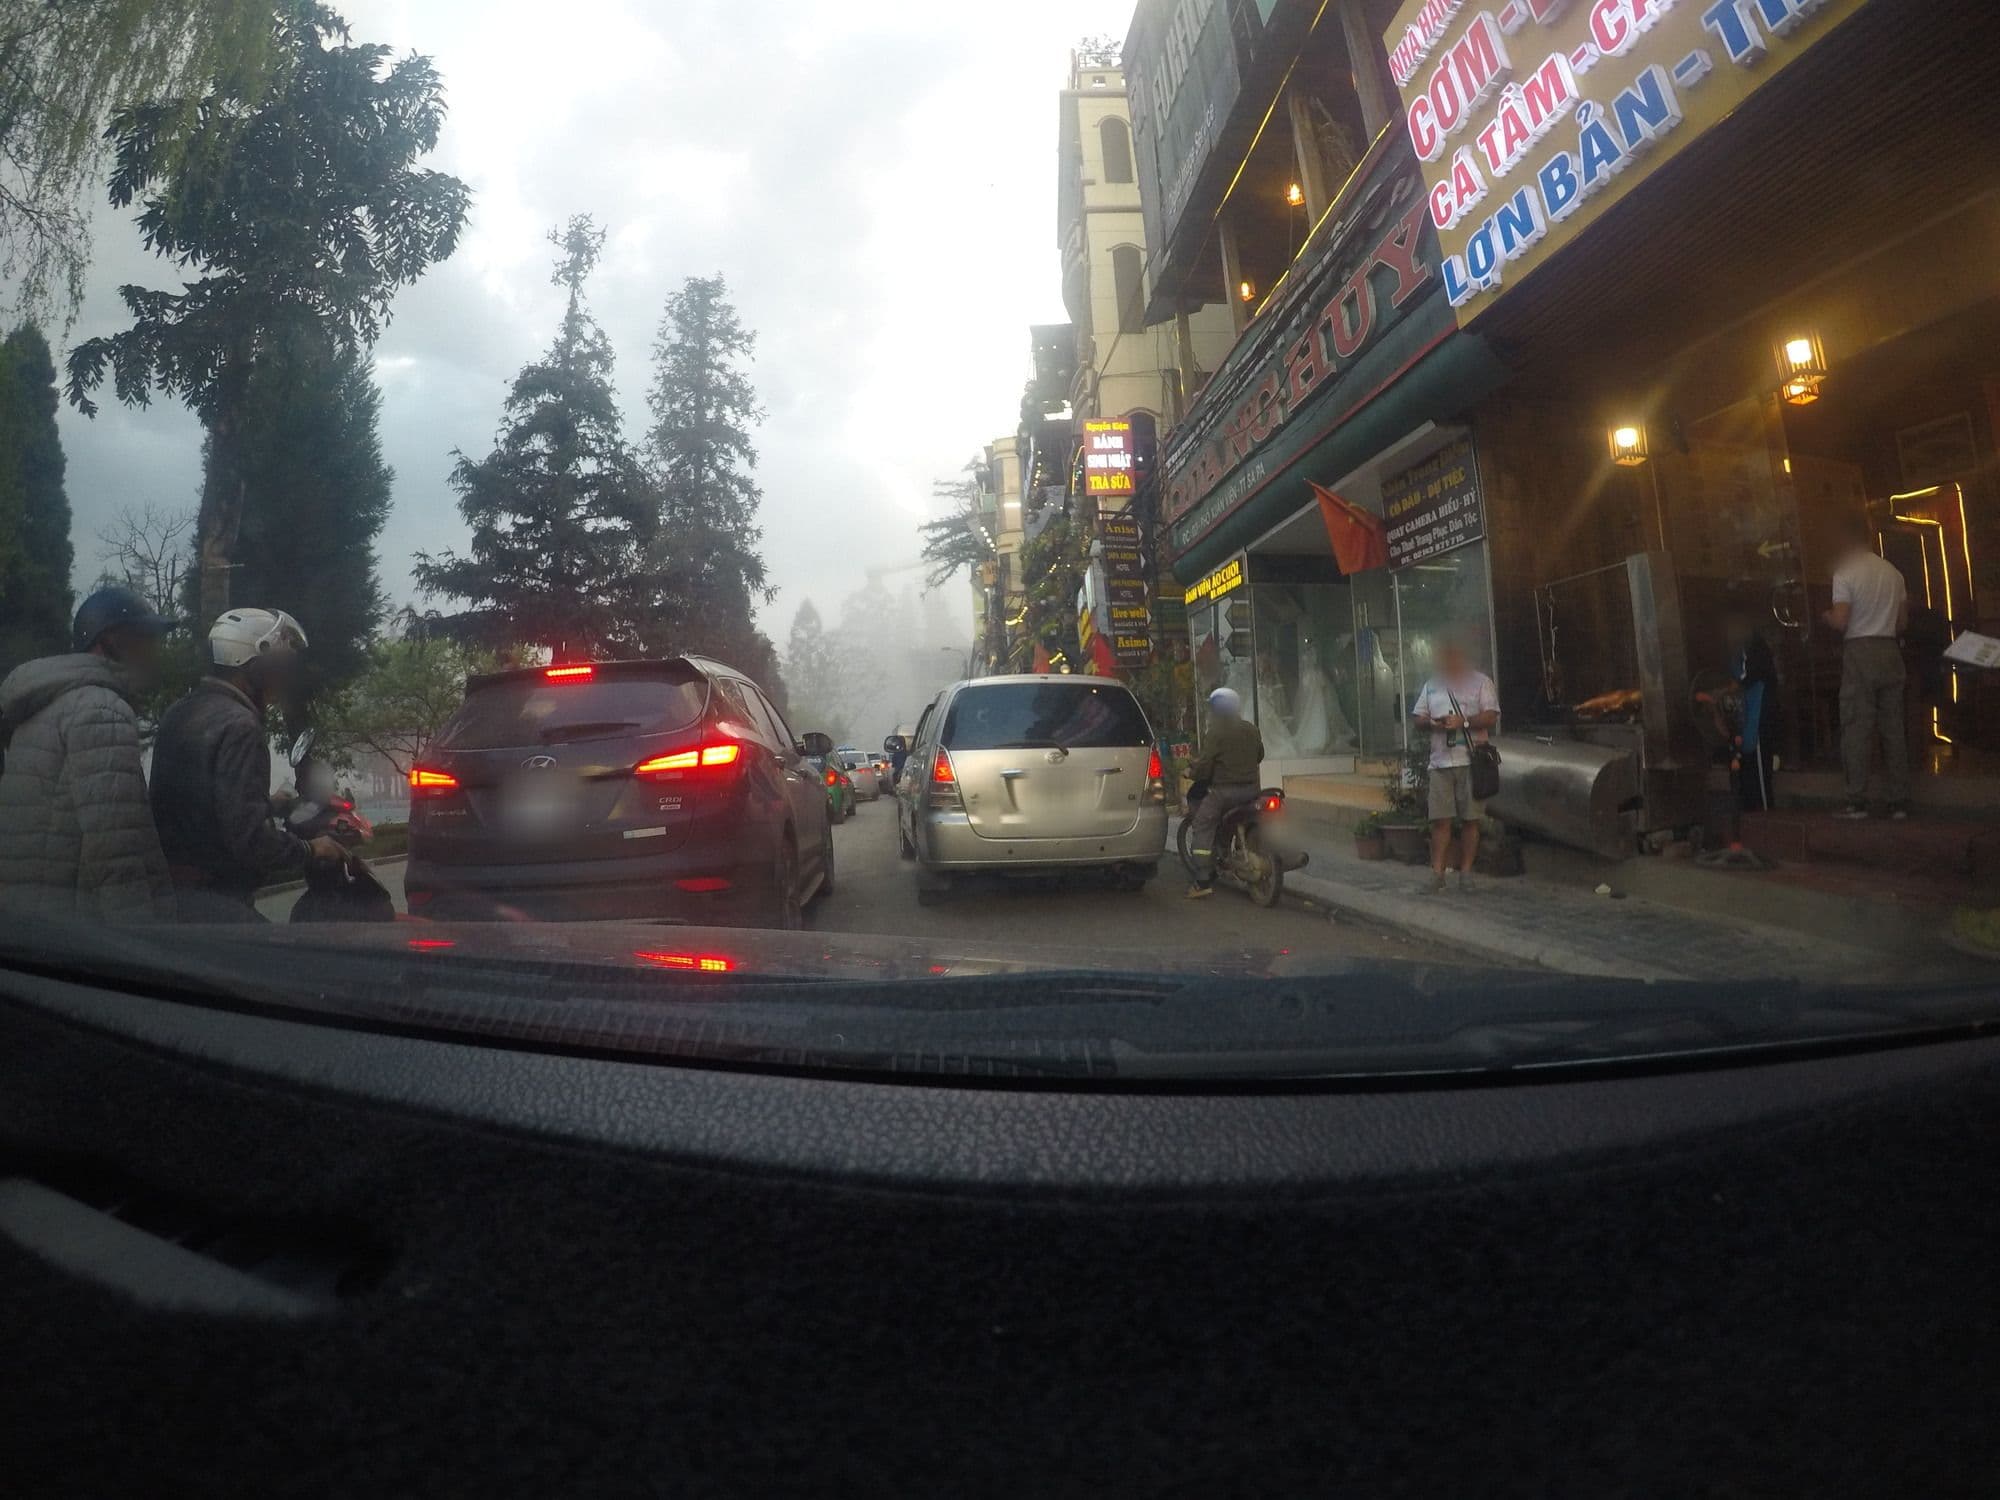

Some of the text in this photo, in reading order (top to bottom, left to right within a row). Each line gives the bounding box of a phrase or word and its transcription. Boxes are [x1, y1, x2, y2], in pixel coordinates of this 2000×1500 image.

[1429, 146, 1482, 230] CÁ
[1441, 185, 1540, 306] LỢN
[1283, 192, 1434, 413] HUY
[1093, 433, 1124, 449] BÁNH
[1090, 472, 1131, 489] TRÀ SỮA
[1404, 509, 1438, 534] CAMERA
